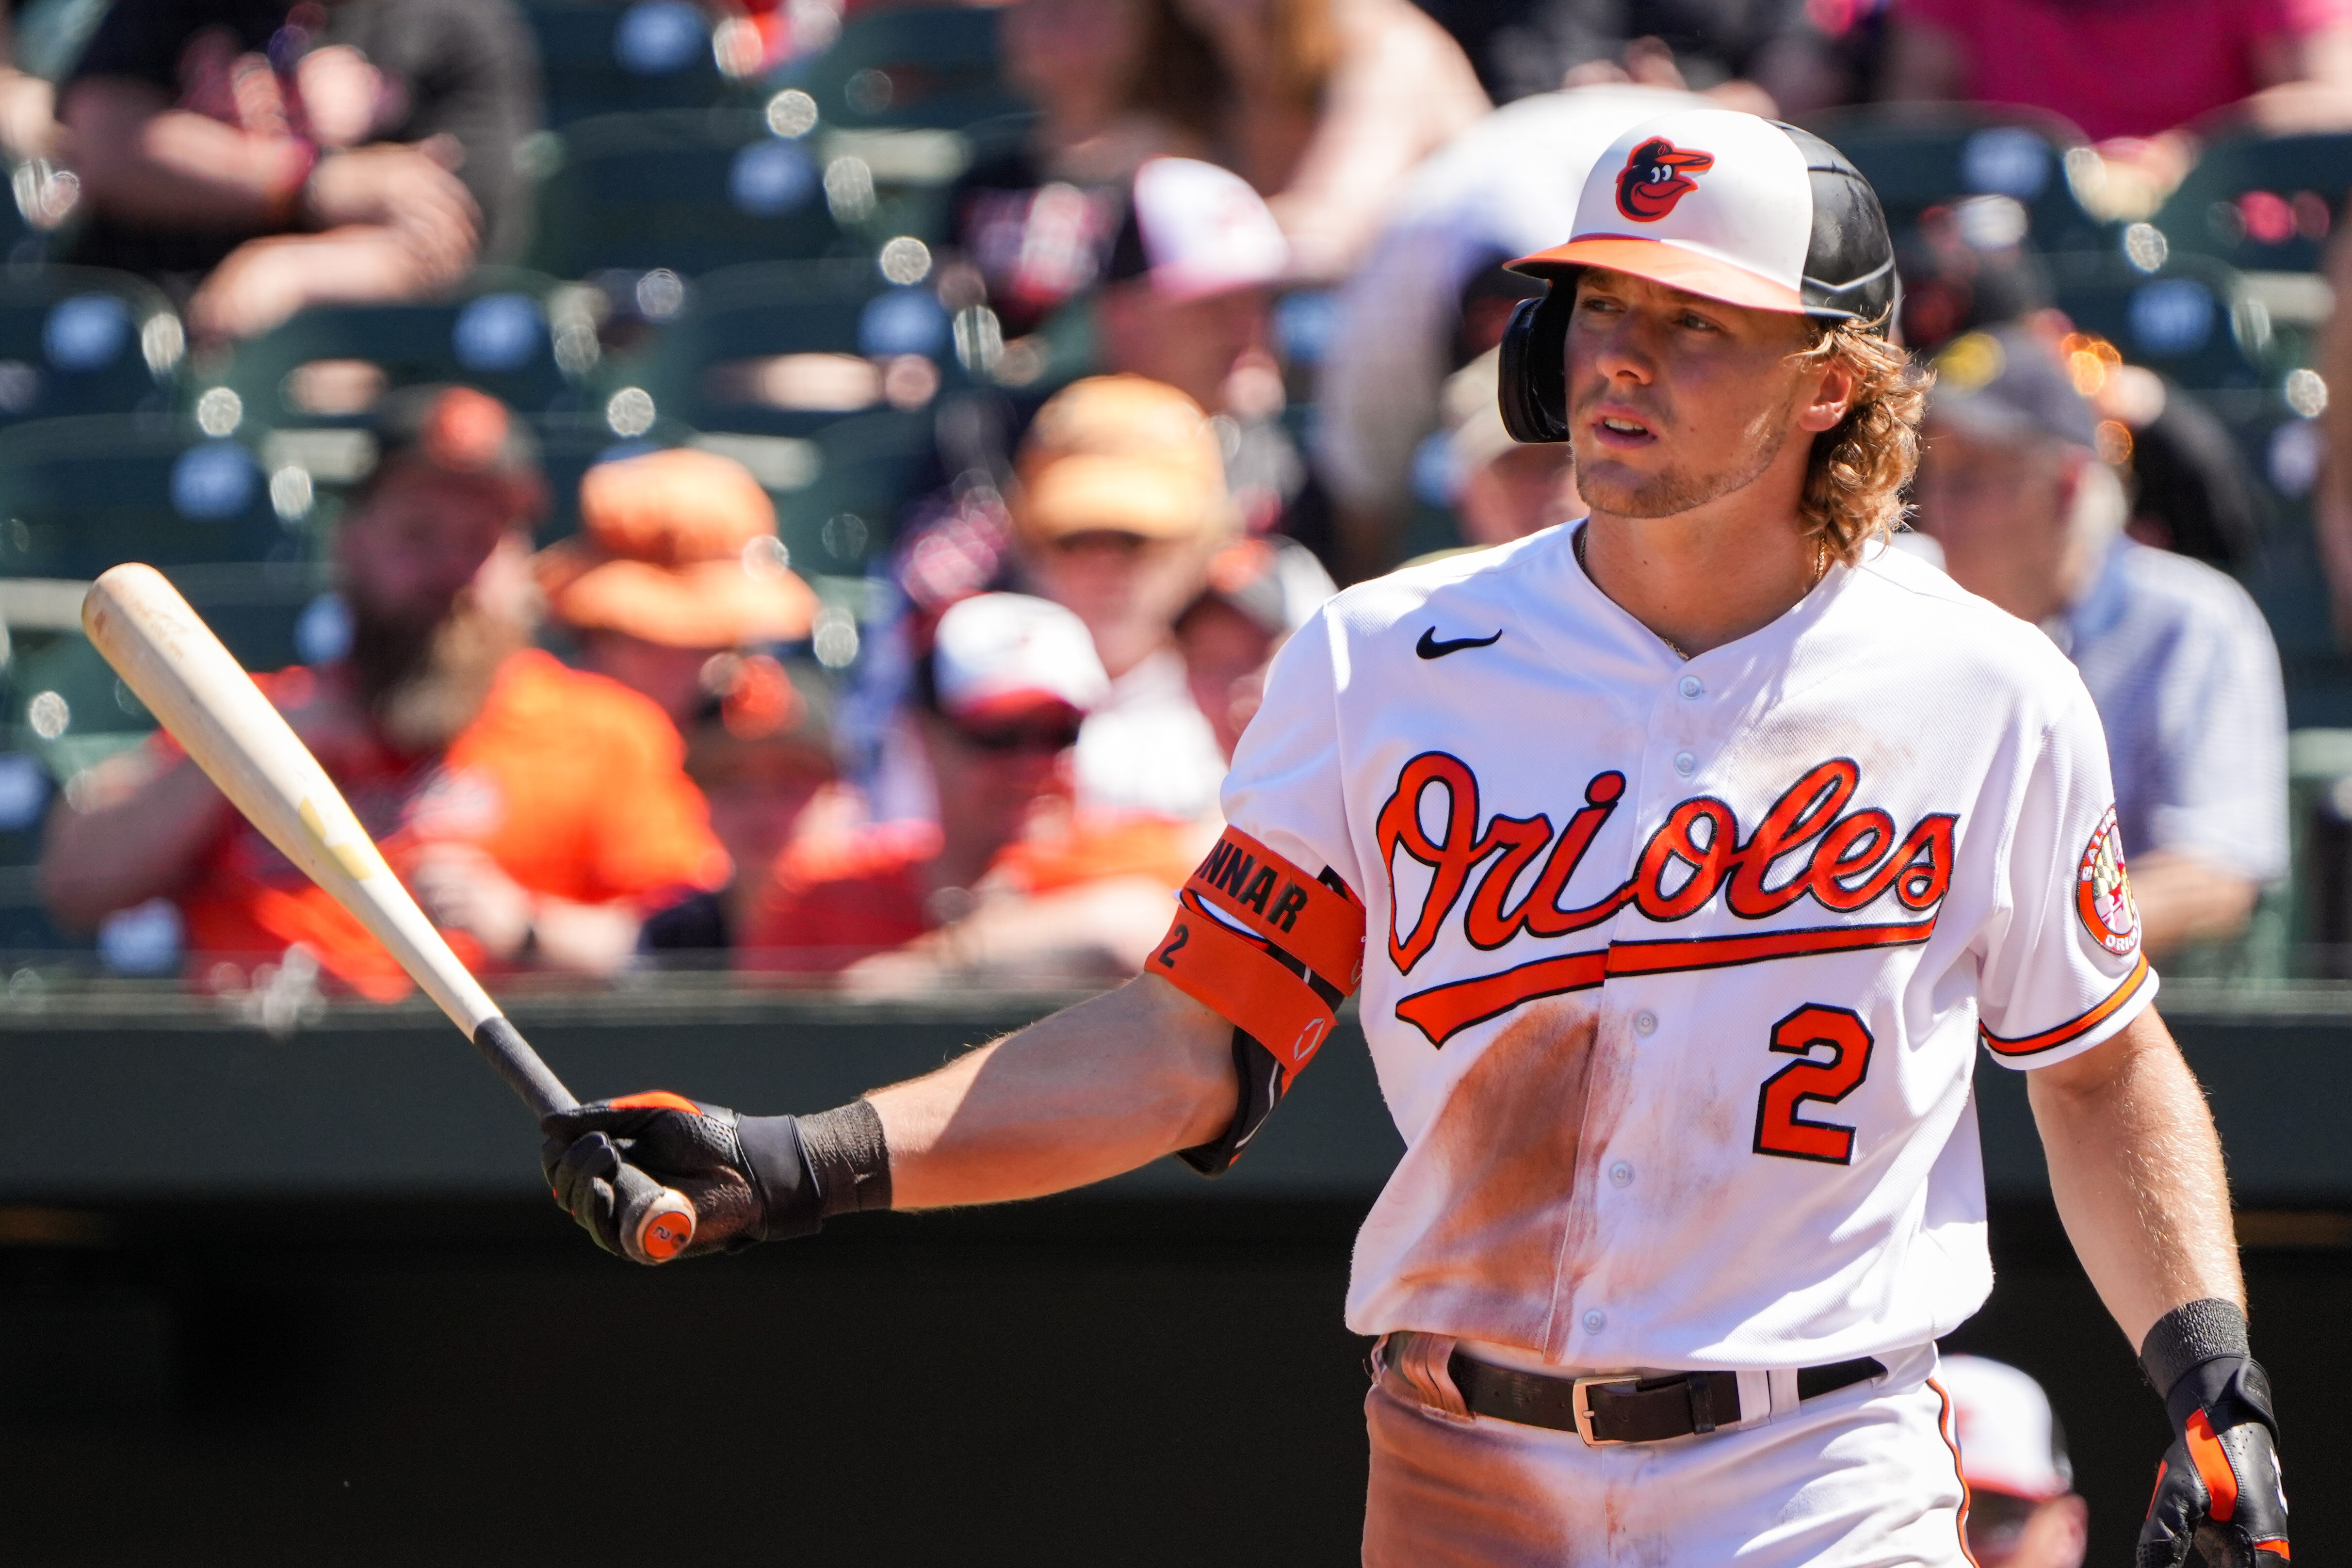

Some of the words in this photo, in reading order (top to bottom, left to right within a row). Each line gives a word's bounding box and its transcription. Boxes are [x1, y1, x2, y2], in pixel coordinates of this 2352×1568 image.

[1194, 839, 1308, 934] NNAR
[1376, 750, 1961, 975] Orioles
[1158, 923, 1189, 969] 2
[1753, 1002, 1874, 1165] 2
